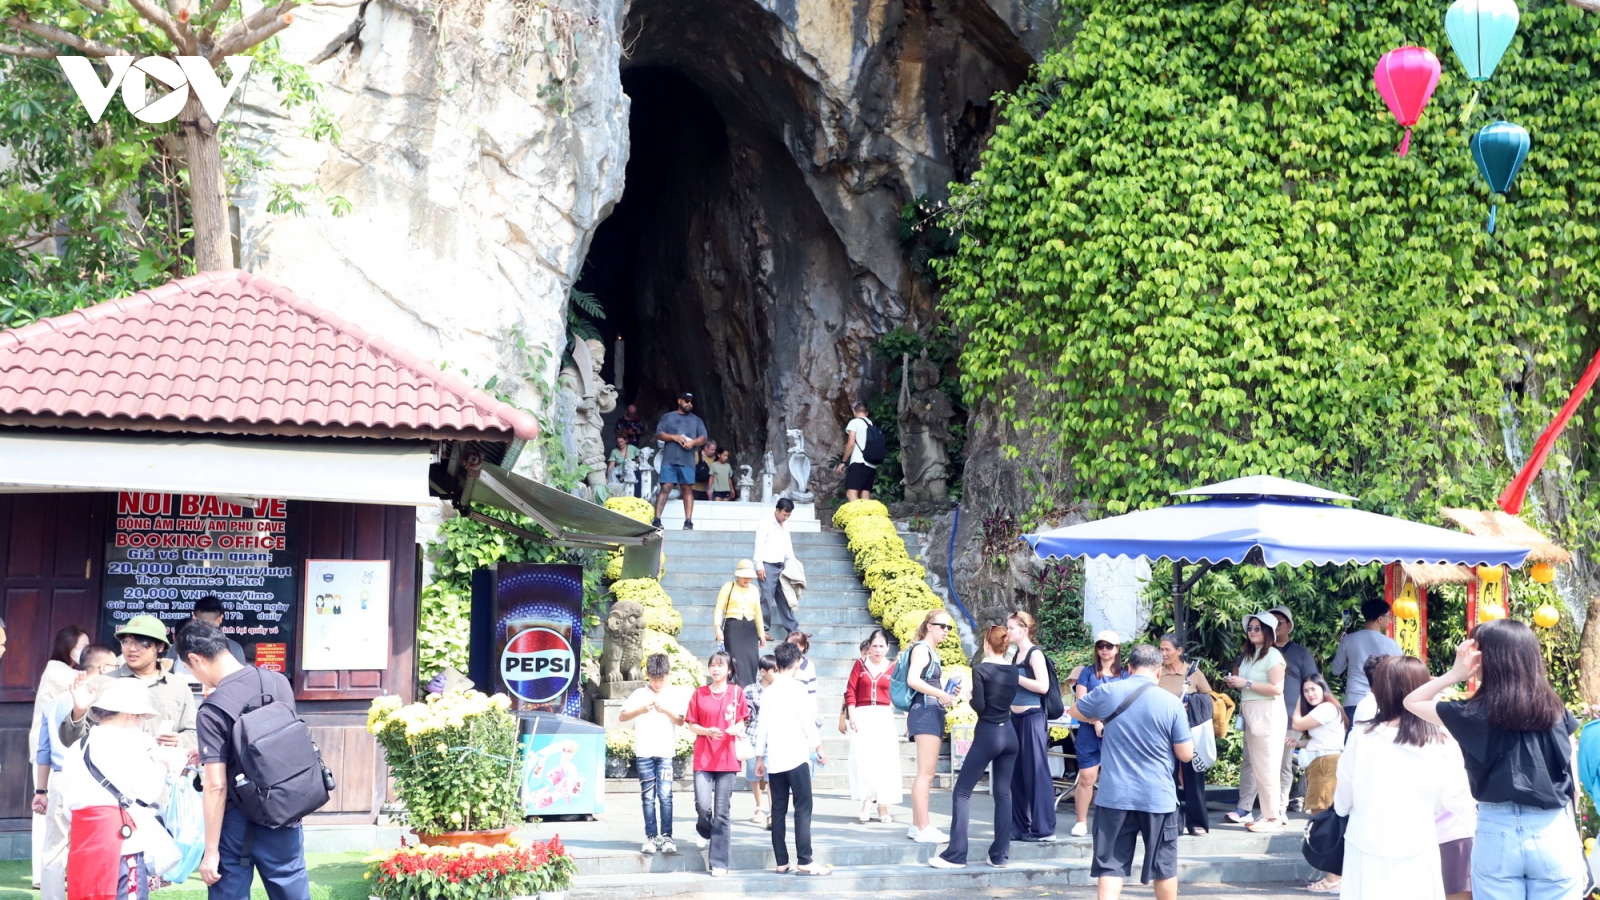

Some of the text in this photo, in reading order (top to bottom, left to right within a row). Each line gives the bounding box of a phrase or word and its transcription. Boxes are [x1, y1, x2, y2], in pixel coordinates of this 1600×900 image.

[116, 516, 151, 532] ĐỘNG
[154, 517, 174, 530] ÂM
[208, 520, 226, 531] AM
[230, 520, 253, 532] PHU
[257, 521, 286, 533] CAVE
[115, 532, 286, 550] BOOKING OFFICE
[127, 548, 155, 560] Giá
[182, 549, 223, 561] tham
[229, 552, 273, 563] quan:
[108, 562, 173, 575] 20.000
[135, 575, 265, 587] The entrance ticket
[124, 587, 178, 600] 20.000
[257, 611, 283, 622] daily
[506, 657, 570, 672] PEPSI
